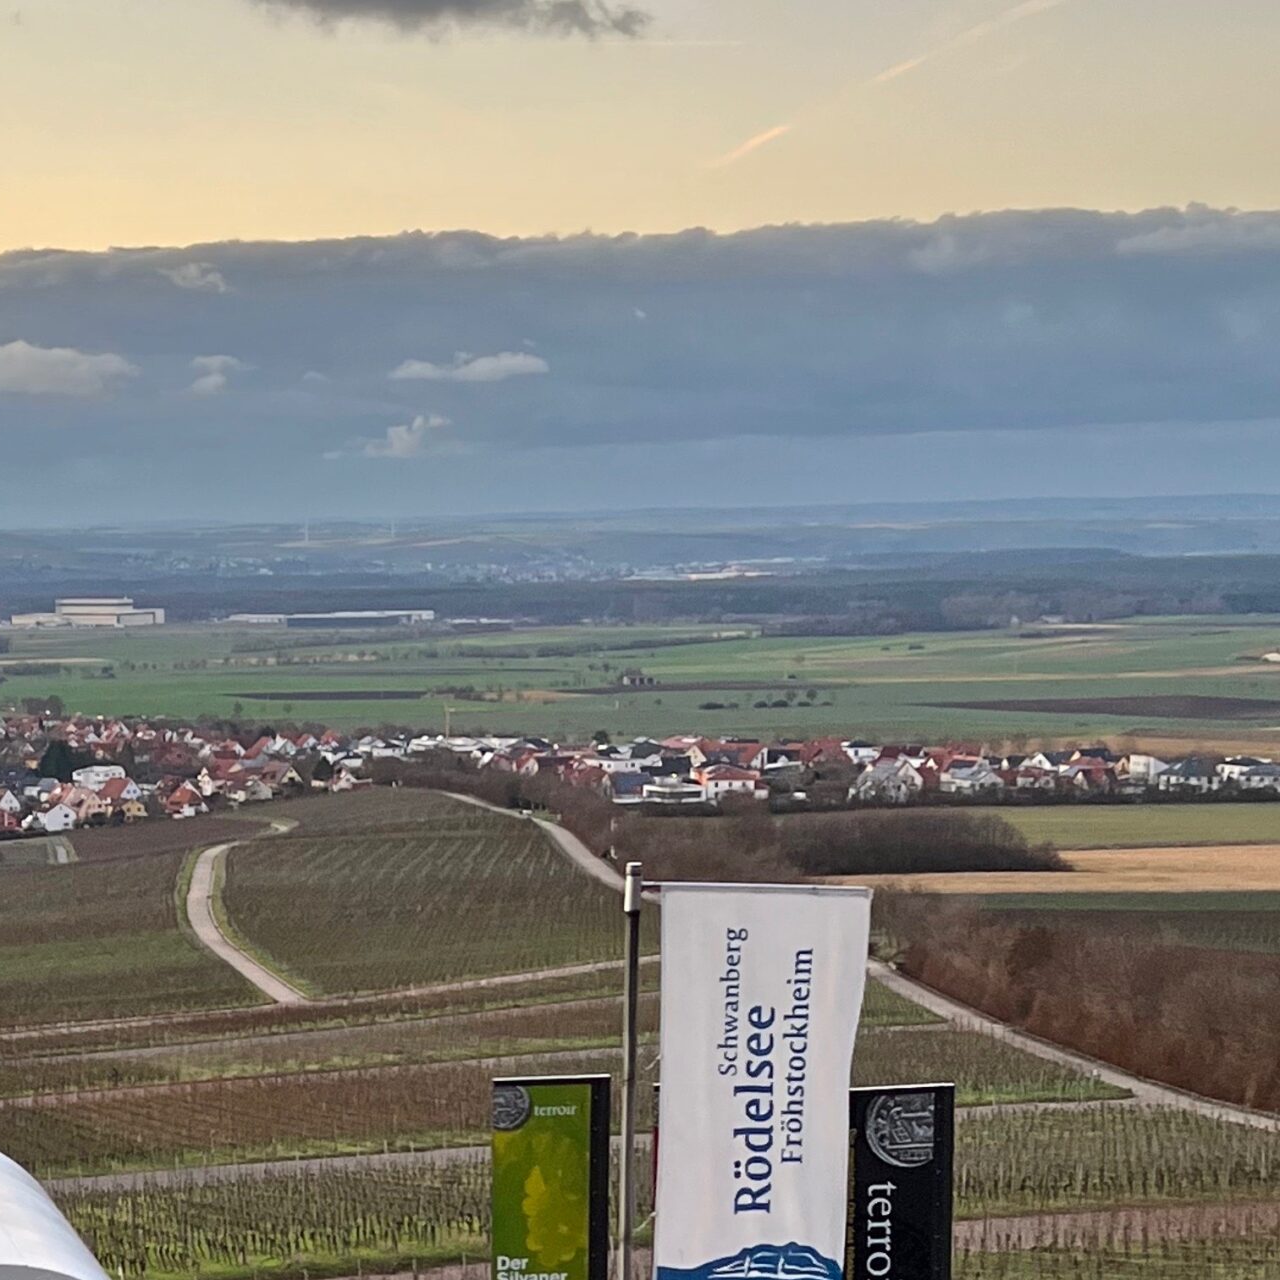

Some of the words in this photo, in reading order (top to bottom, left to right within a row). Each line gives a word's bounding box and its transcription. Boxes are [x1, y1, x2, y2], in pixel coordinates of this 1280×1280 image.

[717, 927, 749, 1077] Schwanberg
[780, 948, 813, 1164] Fröhstockheim
[733, 1005, 776, 1214] Rödelsee
[496, 1256, 528, 1271] Der
